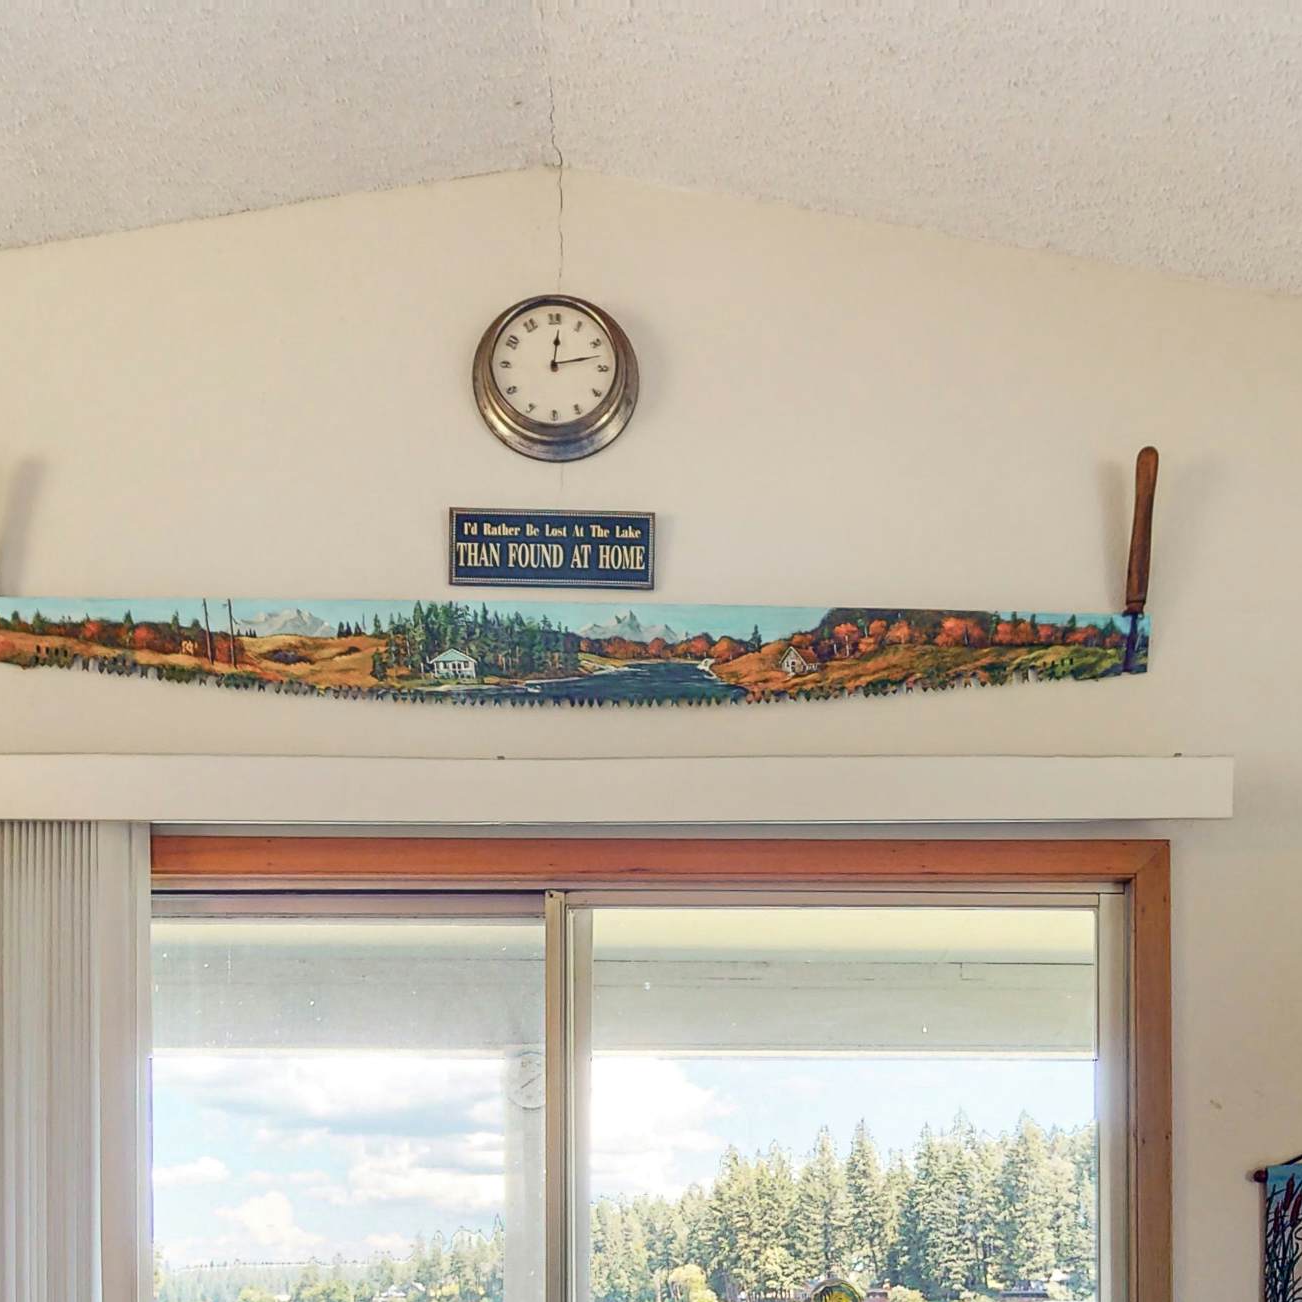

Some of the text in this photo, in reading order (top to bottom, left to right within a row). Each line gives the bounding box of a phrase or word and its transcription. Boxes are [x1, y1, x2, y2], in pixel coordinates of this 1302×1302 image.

[506, 335, 520, 350] 10
[463, 522, 641, 539] I'd Rather Be Lost At The Lake
[456, 542, 646, 570] THAN FOUND AT HOME
